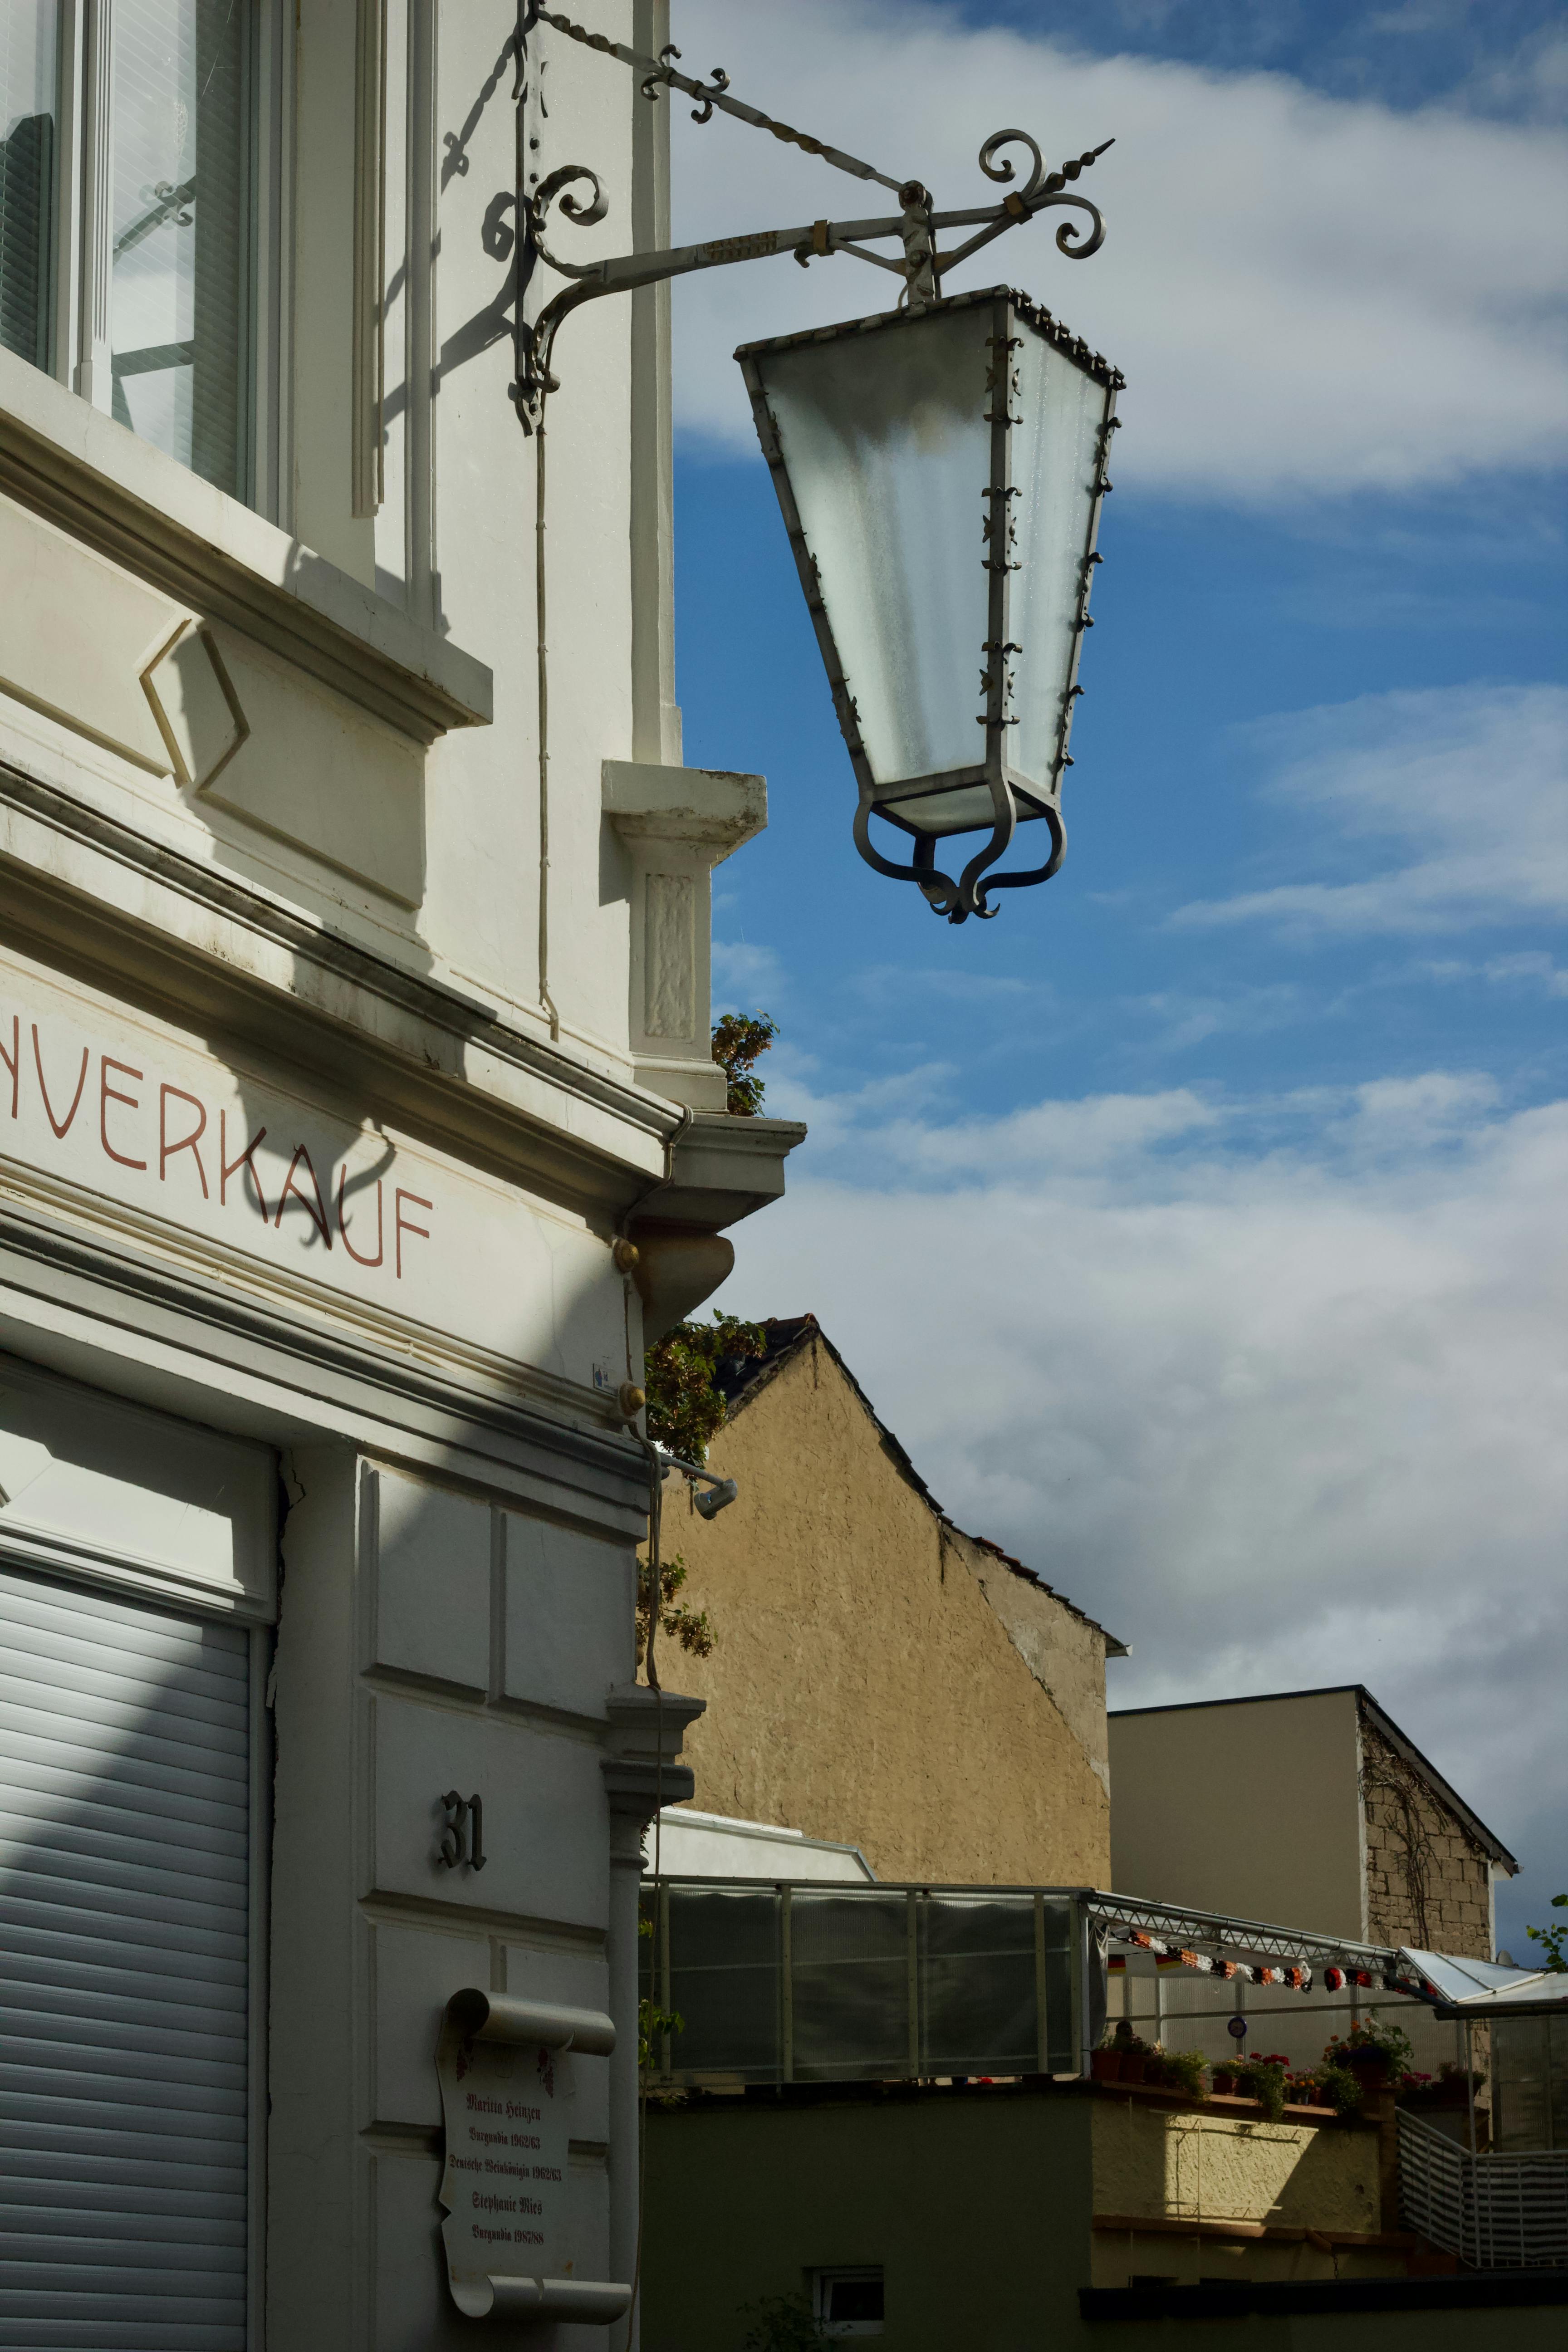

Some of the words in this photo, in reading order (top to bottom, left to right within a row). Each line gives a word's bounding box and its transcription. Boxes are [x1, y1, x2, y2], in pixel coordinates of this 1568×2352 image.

[439, 1790, 487, 1872] 31
[469, 2127, 508, 2146] Burgundia
[511, 2134, 541, 2150] 1962/63
[449, 2154, 482, 2173] Deutsche
[485, 2158, 530, 2180] Weinkönigin
[533, 2166, 562, 2182] 1962/63
[472, 2191, 516, 2215] Stephanie
[472, 2224, 511, 2244] Burgundia
[514, 2230, 544, 2245] 1987/88
